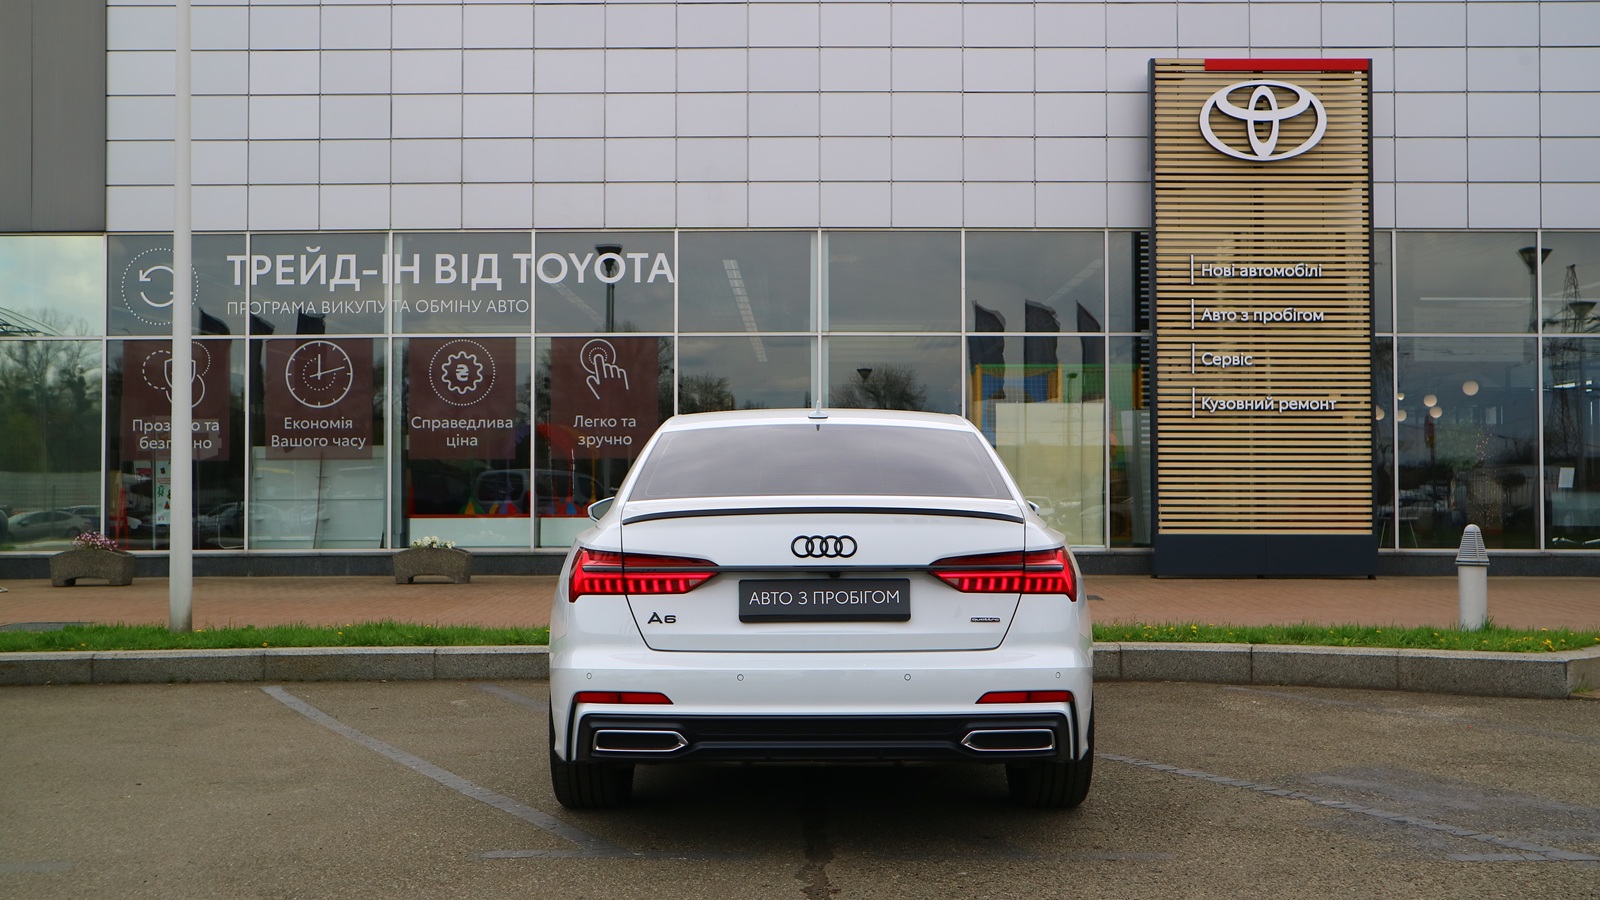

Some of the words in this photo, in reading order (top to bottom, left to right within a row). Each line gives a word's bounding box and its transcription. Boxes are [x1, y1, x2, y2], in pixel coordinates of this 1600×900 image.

[226, 245, 420, 292] ТРЕЙД-ІН
[435, 253, 503, 292] ВІД
[512, 252, 676, 284] TOYOTA
[1201, 263, 1236, 277] Нові
[1239, 263, 1323, 278] автомобілі
[227, 300, 317, 315] ПРОГРАМА
[321, 300, 388, 315] ВИКУПУ
[392, 299, 411, 313] ТА
[415, 299, 482, 314] ОБМІНУ
[486, 299, 530, 314] АВТО
[1201, 307, 1237, 322] Авто
[1240, 311, 1249, 322] з
[1253, 307, 1325, 325] пробігом
[1201, 352, 1253, 369] Сервіс
[1201, 396, 1274, 414] Кузовний
[1278, 400, 1337, 414] ремонт
[132, 418, 200, 435] Прозо
[204, 421, 220, 432] та
[284, 416, 353, 430] Економія
[411, 416, 514, 433] Справедлива
[573, 415, 617, 429] Легко
[620, 417, 636, 429] та
[271, 435, 328, 448] Вашого
[332, 437, 367, 451] часу
[446, 434, 478, 448] ціна
[577, 436, 633, 449] зручно
[749, 591, 793, 606] АВТО
[798, 591, 808, 605] З
[813, 589, 900, 605] ПРОБІГОМ
[647, 611, 677, 625] A6
